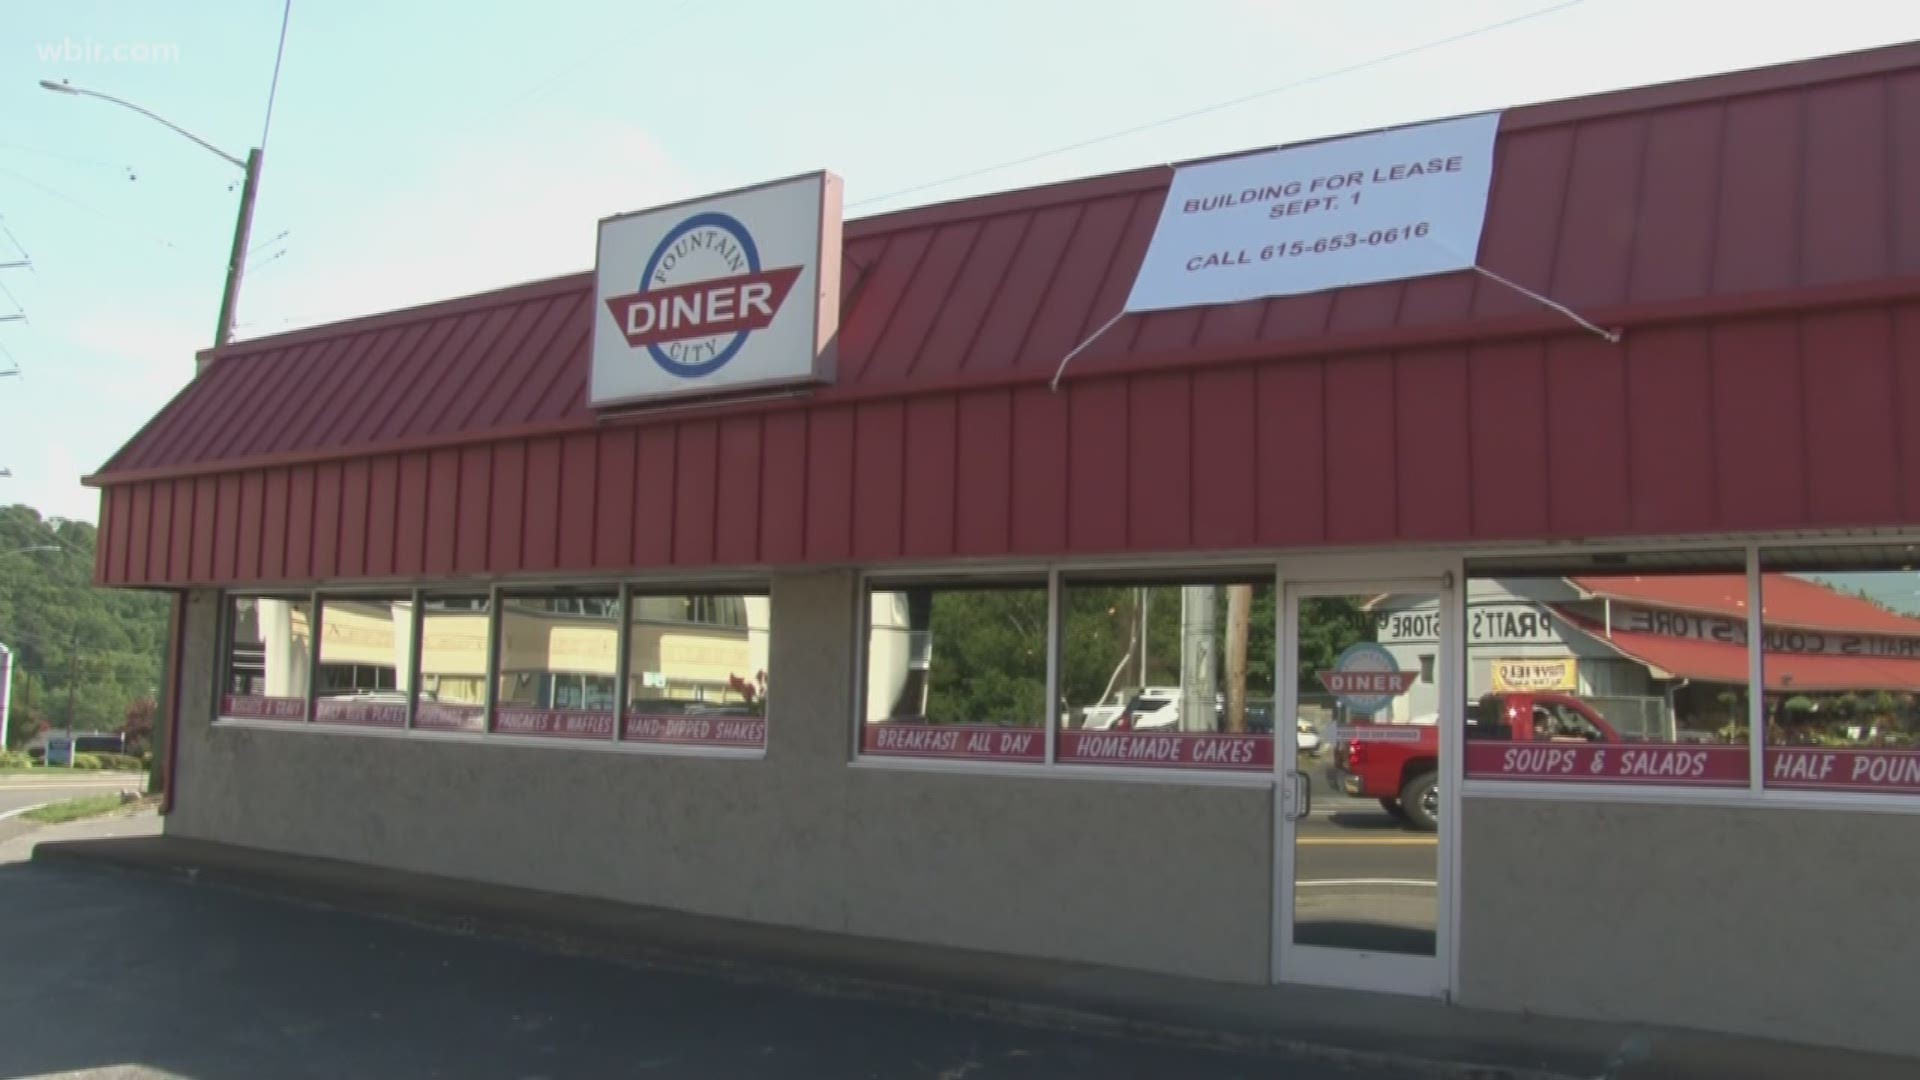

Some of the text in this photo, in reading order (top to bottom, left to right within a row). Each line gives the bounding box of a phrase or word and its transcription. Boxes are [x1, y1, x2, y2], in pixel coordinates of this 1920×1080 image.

[1182, 156, 1463, 213] BUILDING FOR LEASE
[1269, 192, 1361, 219] SEPT. 1
[655, 231, 744, 283] FOUNTAIN
[1186, 222, 1429, 271] CALL 615-653-0616
[627, 282, 773, 336] DINER
[669, 339, 717, 362] CITY
[1331, 675, 1402, 690] DINER
[499, 712, 549, 730] PANCAKES
[566, 715, 612, 733] WAFFLES
[627, 718, 765, 740] HAND-DIPPED SHAKES
[877, 729, 1032, 754] BREAKFAST ALL DAY
[1077, 736, 1256, 763] HOMEMADE CAKES
[1502, 748, 1708, 776] SOUPS & SALADS
[1774, 753, 1836, 780] HALF
